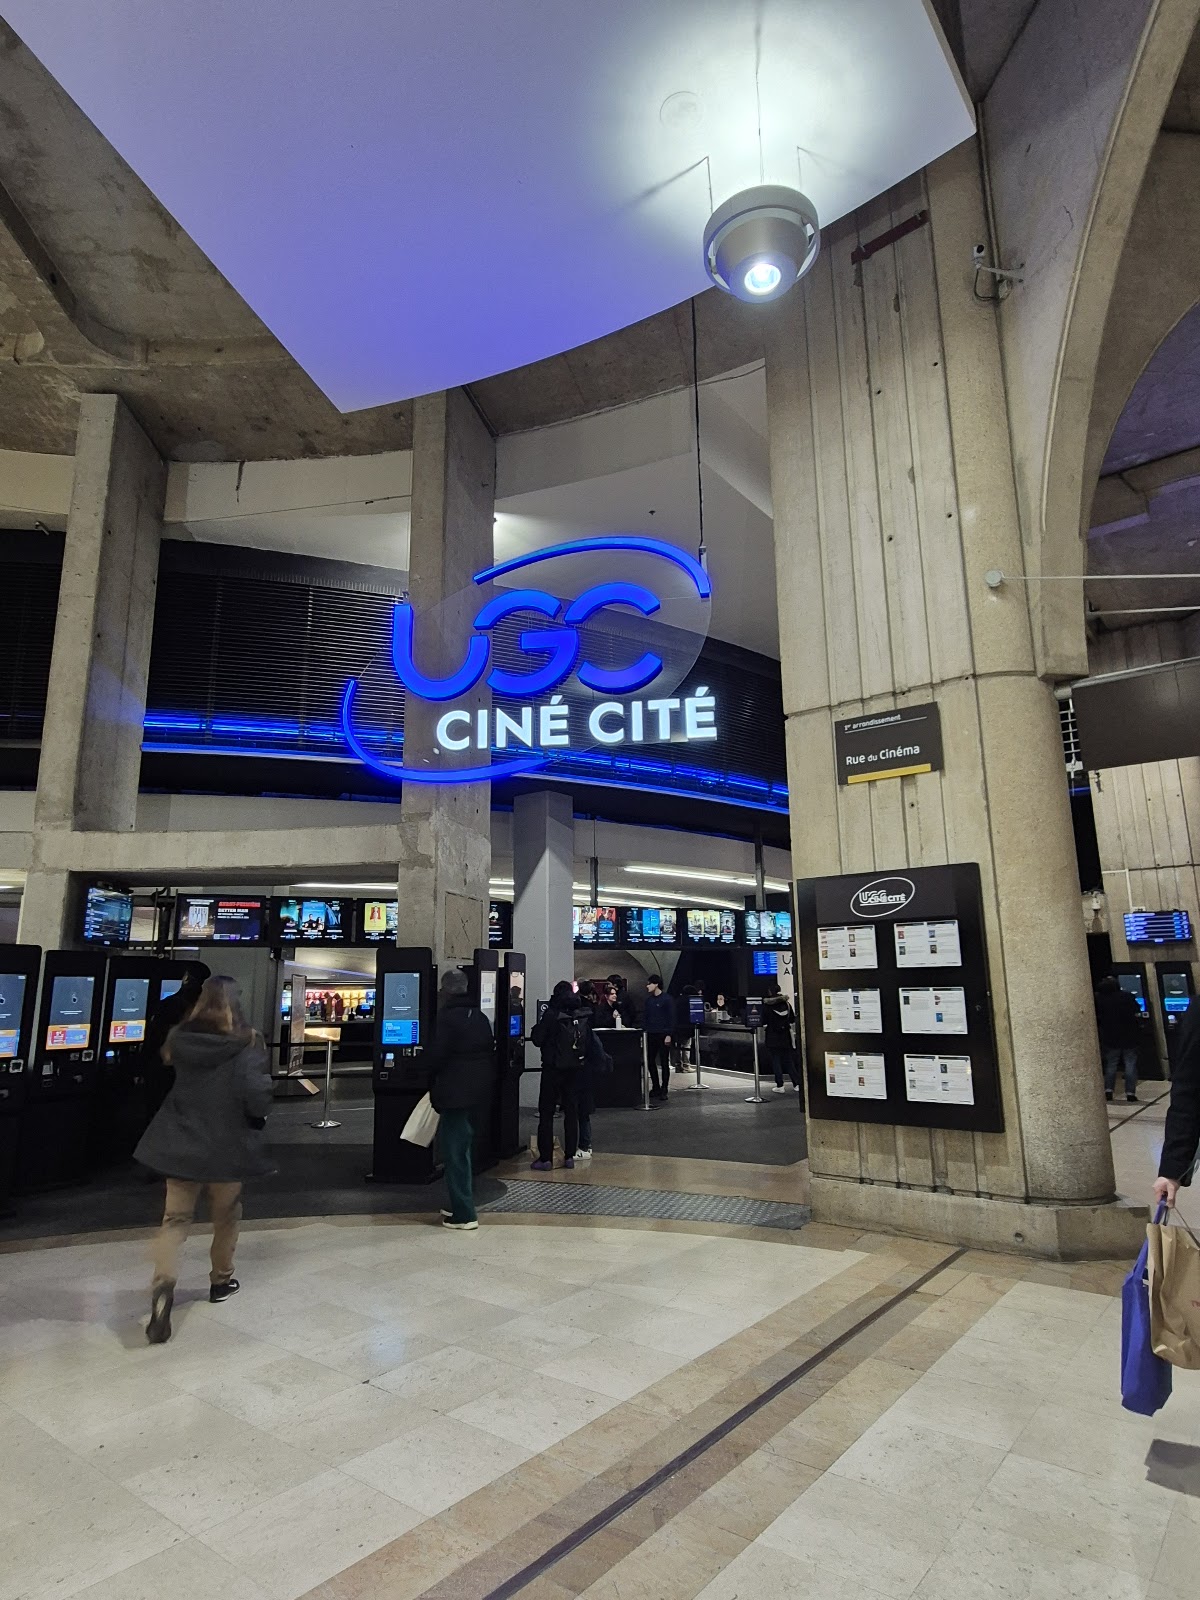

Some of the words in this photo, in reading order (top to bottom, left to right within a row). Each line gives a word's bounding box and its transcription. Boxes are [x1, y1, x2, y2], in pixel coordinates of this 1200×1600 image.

[393, 582, 662, 700] UGC
[436, 695, 570, 750] CINÉ
[589, 687, 717, 743] CITÉ
[853, 714, 901, 729] arrondissement
[846, 754, 866, 766] Rue
[867, 754, 878, 762] du
[879, 745, 920, 759] Cinéma
